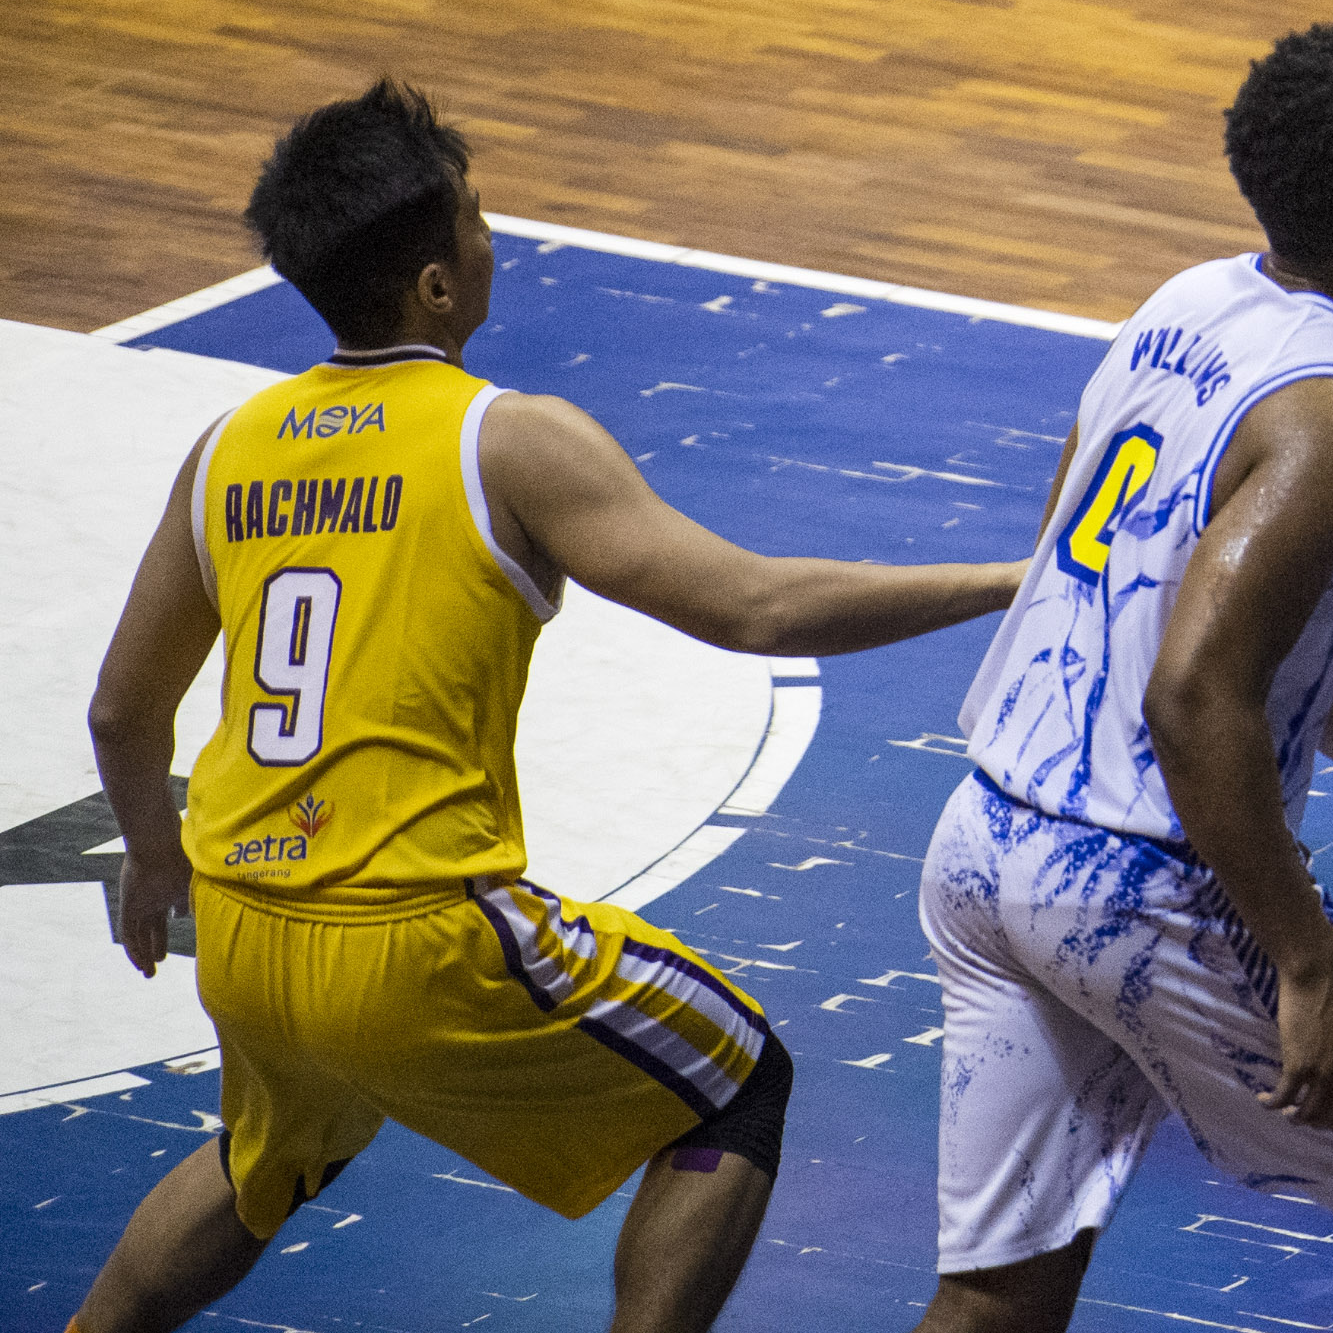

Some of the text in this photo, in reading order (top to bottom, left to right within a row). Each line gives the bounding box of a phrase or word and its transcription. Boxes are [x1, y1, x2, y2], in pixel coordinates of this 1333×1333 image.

[225, 474, 404, 543] RACHMALO
[247, 566, 343, 768] 9
[224, 834, 308, 866] aetra
